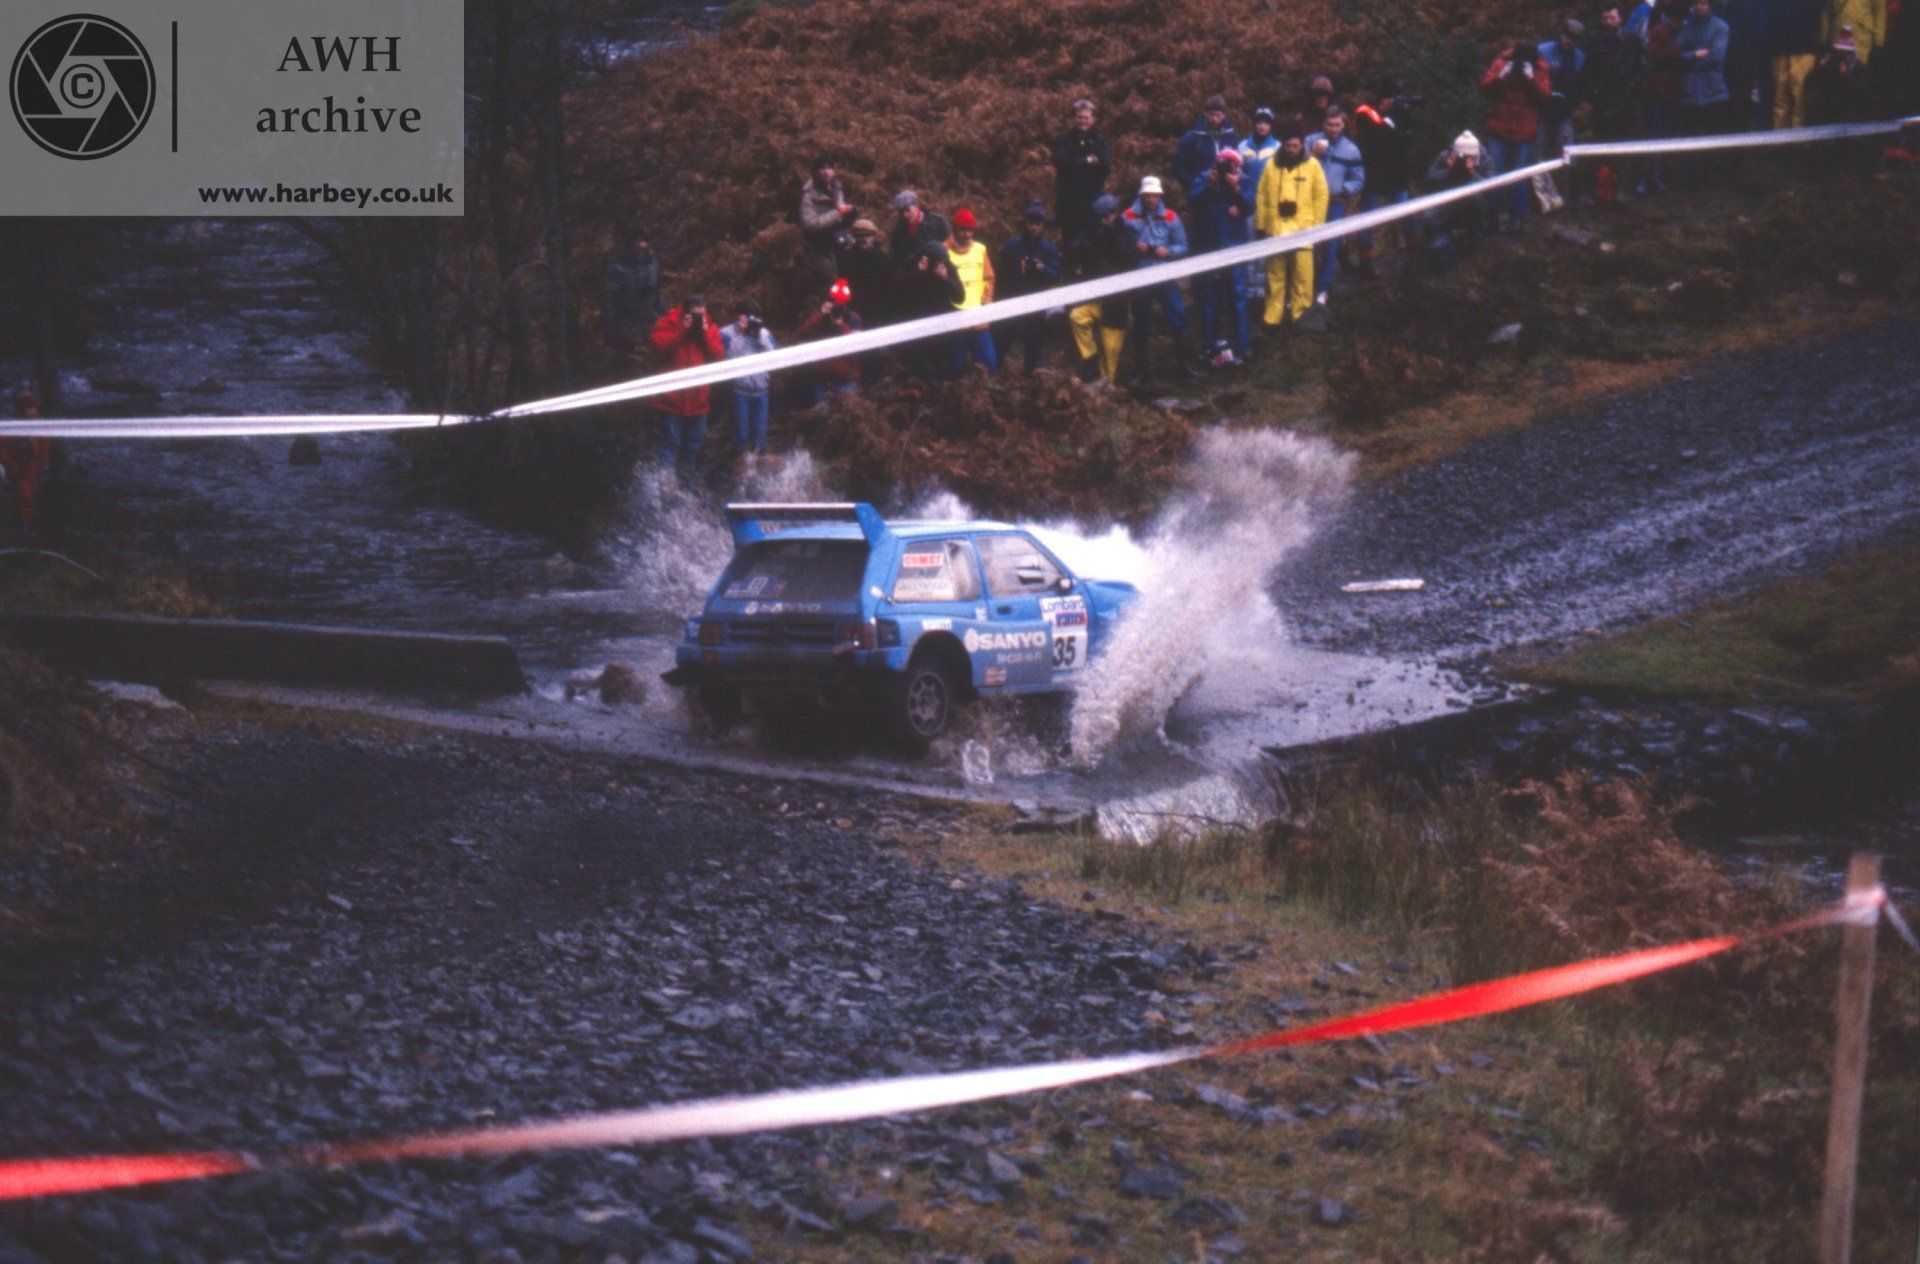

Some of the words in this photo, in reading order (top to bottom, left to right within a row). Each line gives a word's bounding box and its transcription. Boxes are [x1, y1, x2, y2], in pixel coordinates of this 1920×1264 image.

[903, 554, 943, 567] COMET
[979, 631, 1047, 651] SANYO
[1052, 635, 1076, 667] 35
